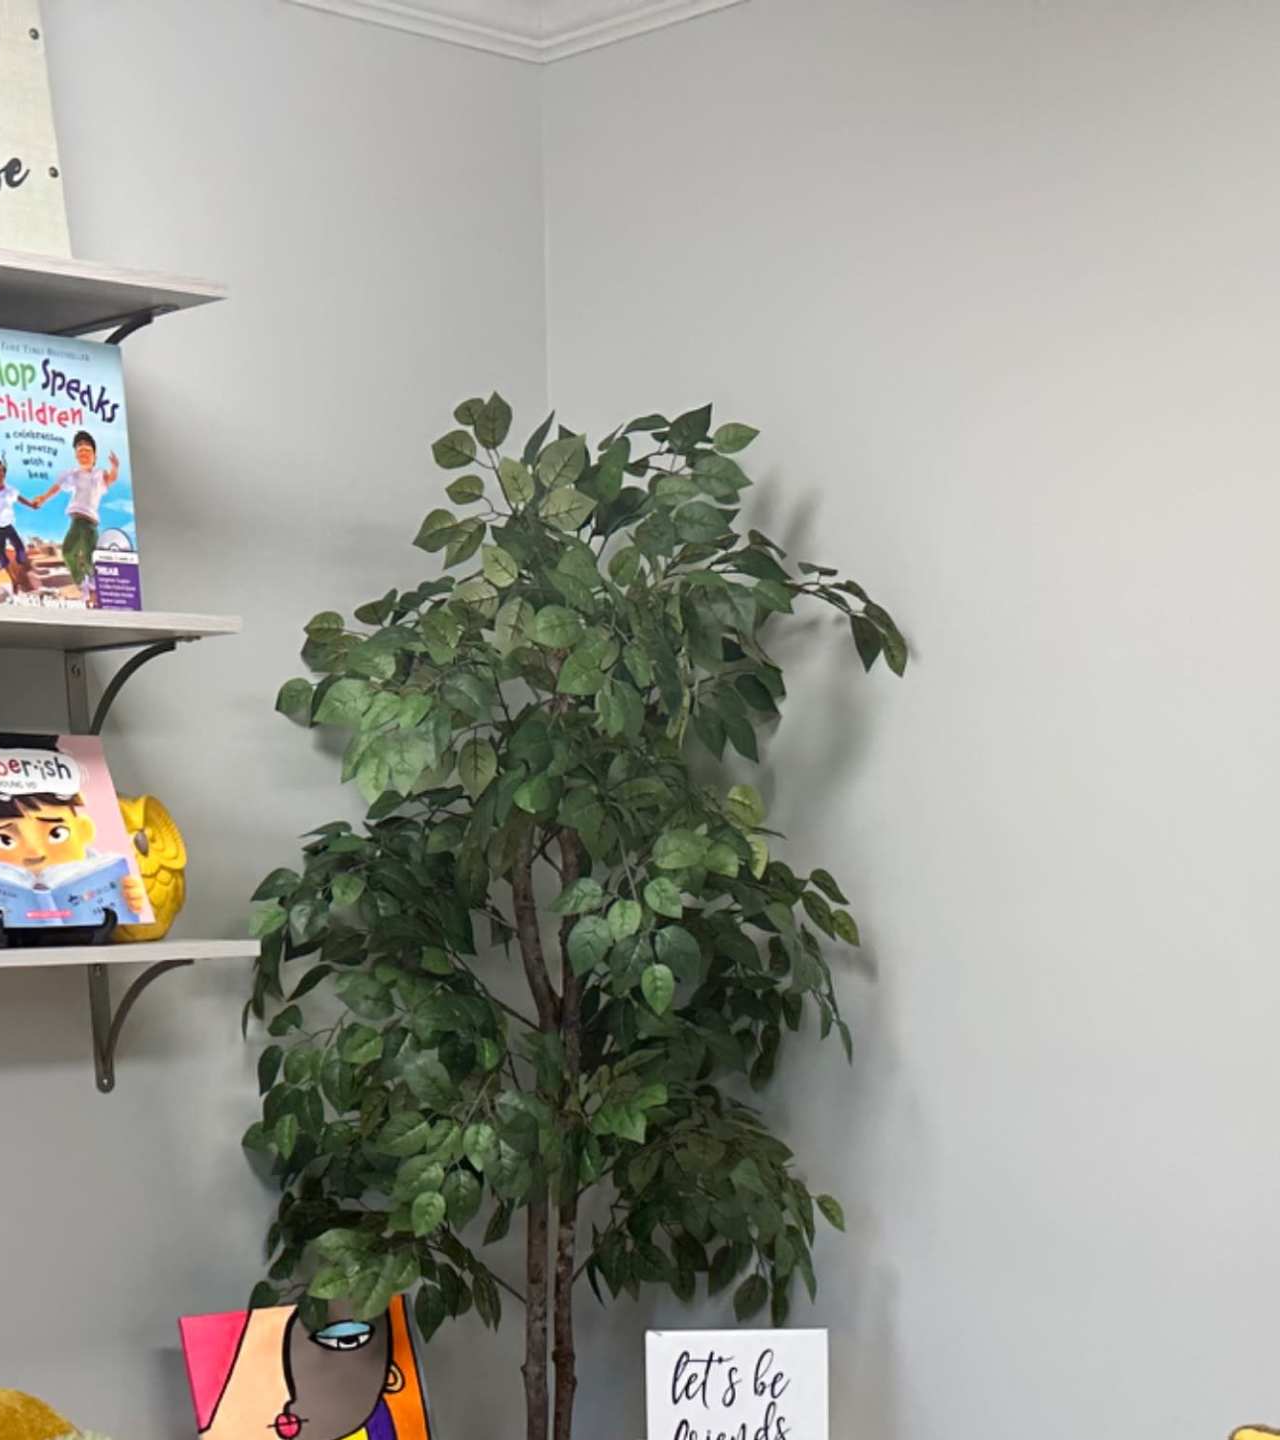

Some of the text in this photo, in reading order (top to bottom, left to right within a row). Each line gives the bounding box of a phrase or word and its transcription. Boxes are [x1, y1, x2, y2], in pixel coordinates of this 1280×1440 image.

[40, 358, 121, 424] Speaks
[671, 1349, 791, 1409] let's be
